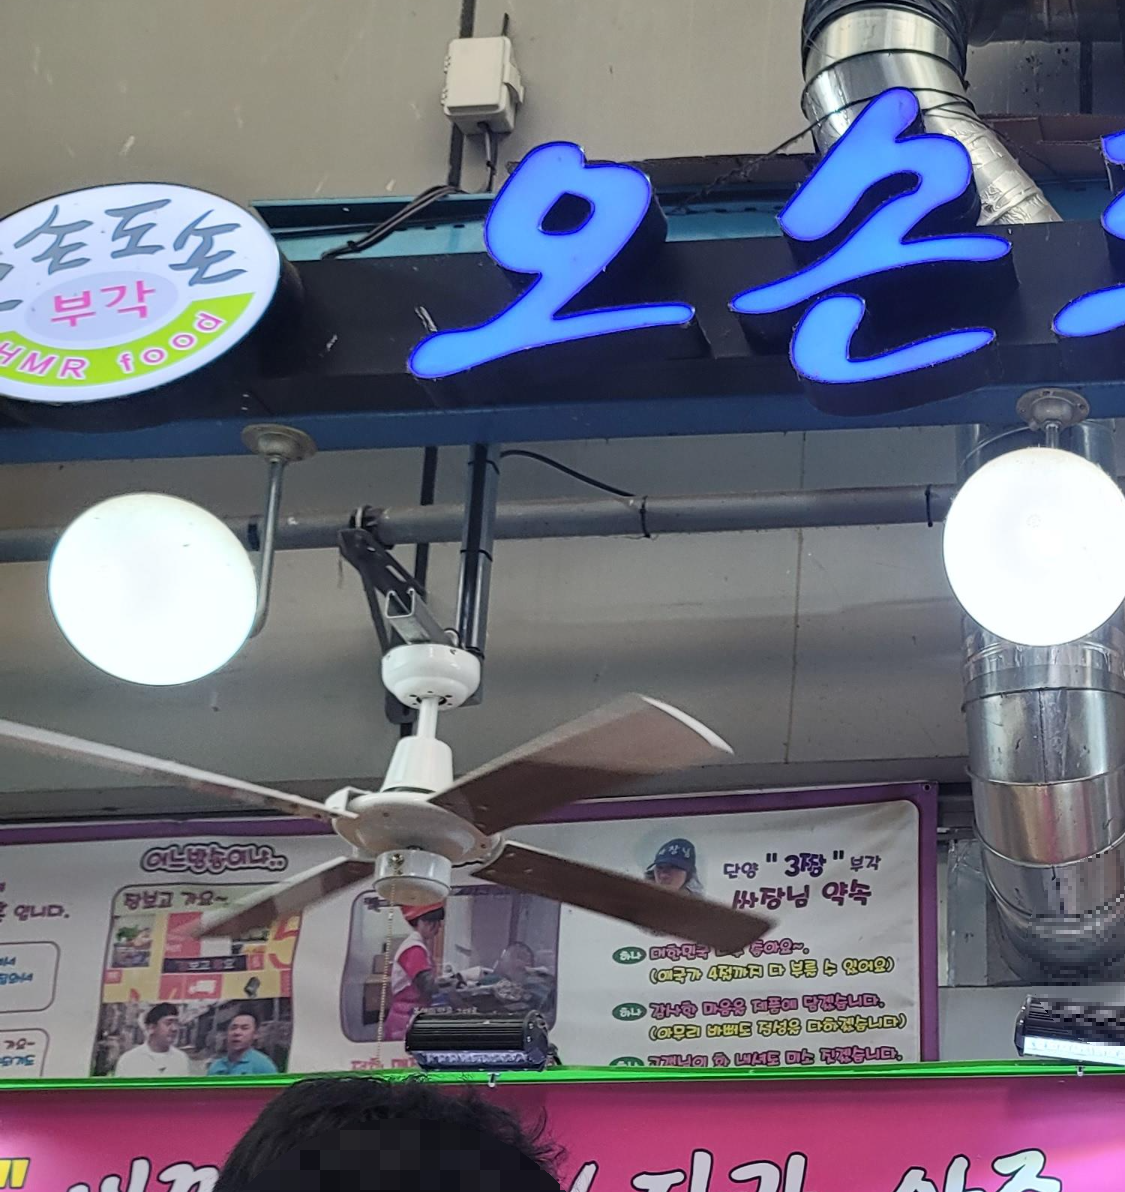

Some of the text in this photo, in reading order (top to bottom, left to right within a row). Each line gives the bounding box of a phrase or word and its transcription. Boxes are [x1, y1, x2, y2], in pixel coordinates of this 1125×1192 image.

[0, 199, 248, 312] 손도손
[51, 280, 156, 327] 부각
[0, 311, 226, 379] HMR food
[723, 861, 759, 880] 단양
[850, 854, 882, 873] 부각
[732, 878, 873, 911] 싸장님 약속
[619, 949, 642, 961] 하나
[649, 943, 711, 961] 대한민국
[649, 955, 896, 985] (애국가 4절까지 다 부를 수 있어요)
[619, 1009, 642, 1019] 하나
[649, 999, 698, 1020] 감사한
[702, 998, 747, 1018] 마음을
[802, 992, 886, 1013] 담겠습니다.
[649, 1025, 702, 1042] (아무리
[756, 1018, 802, 1037] 정성을
[806, 1013, 908, 1034] 다하겠습니다)
[785, 1048, 815, 1065] 미소
